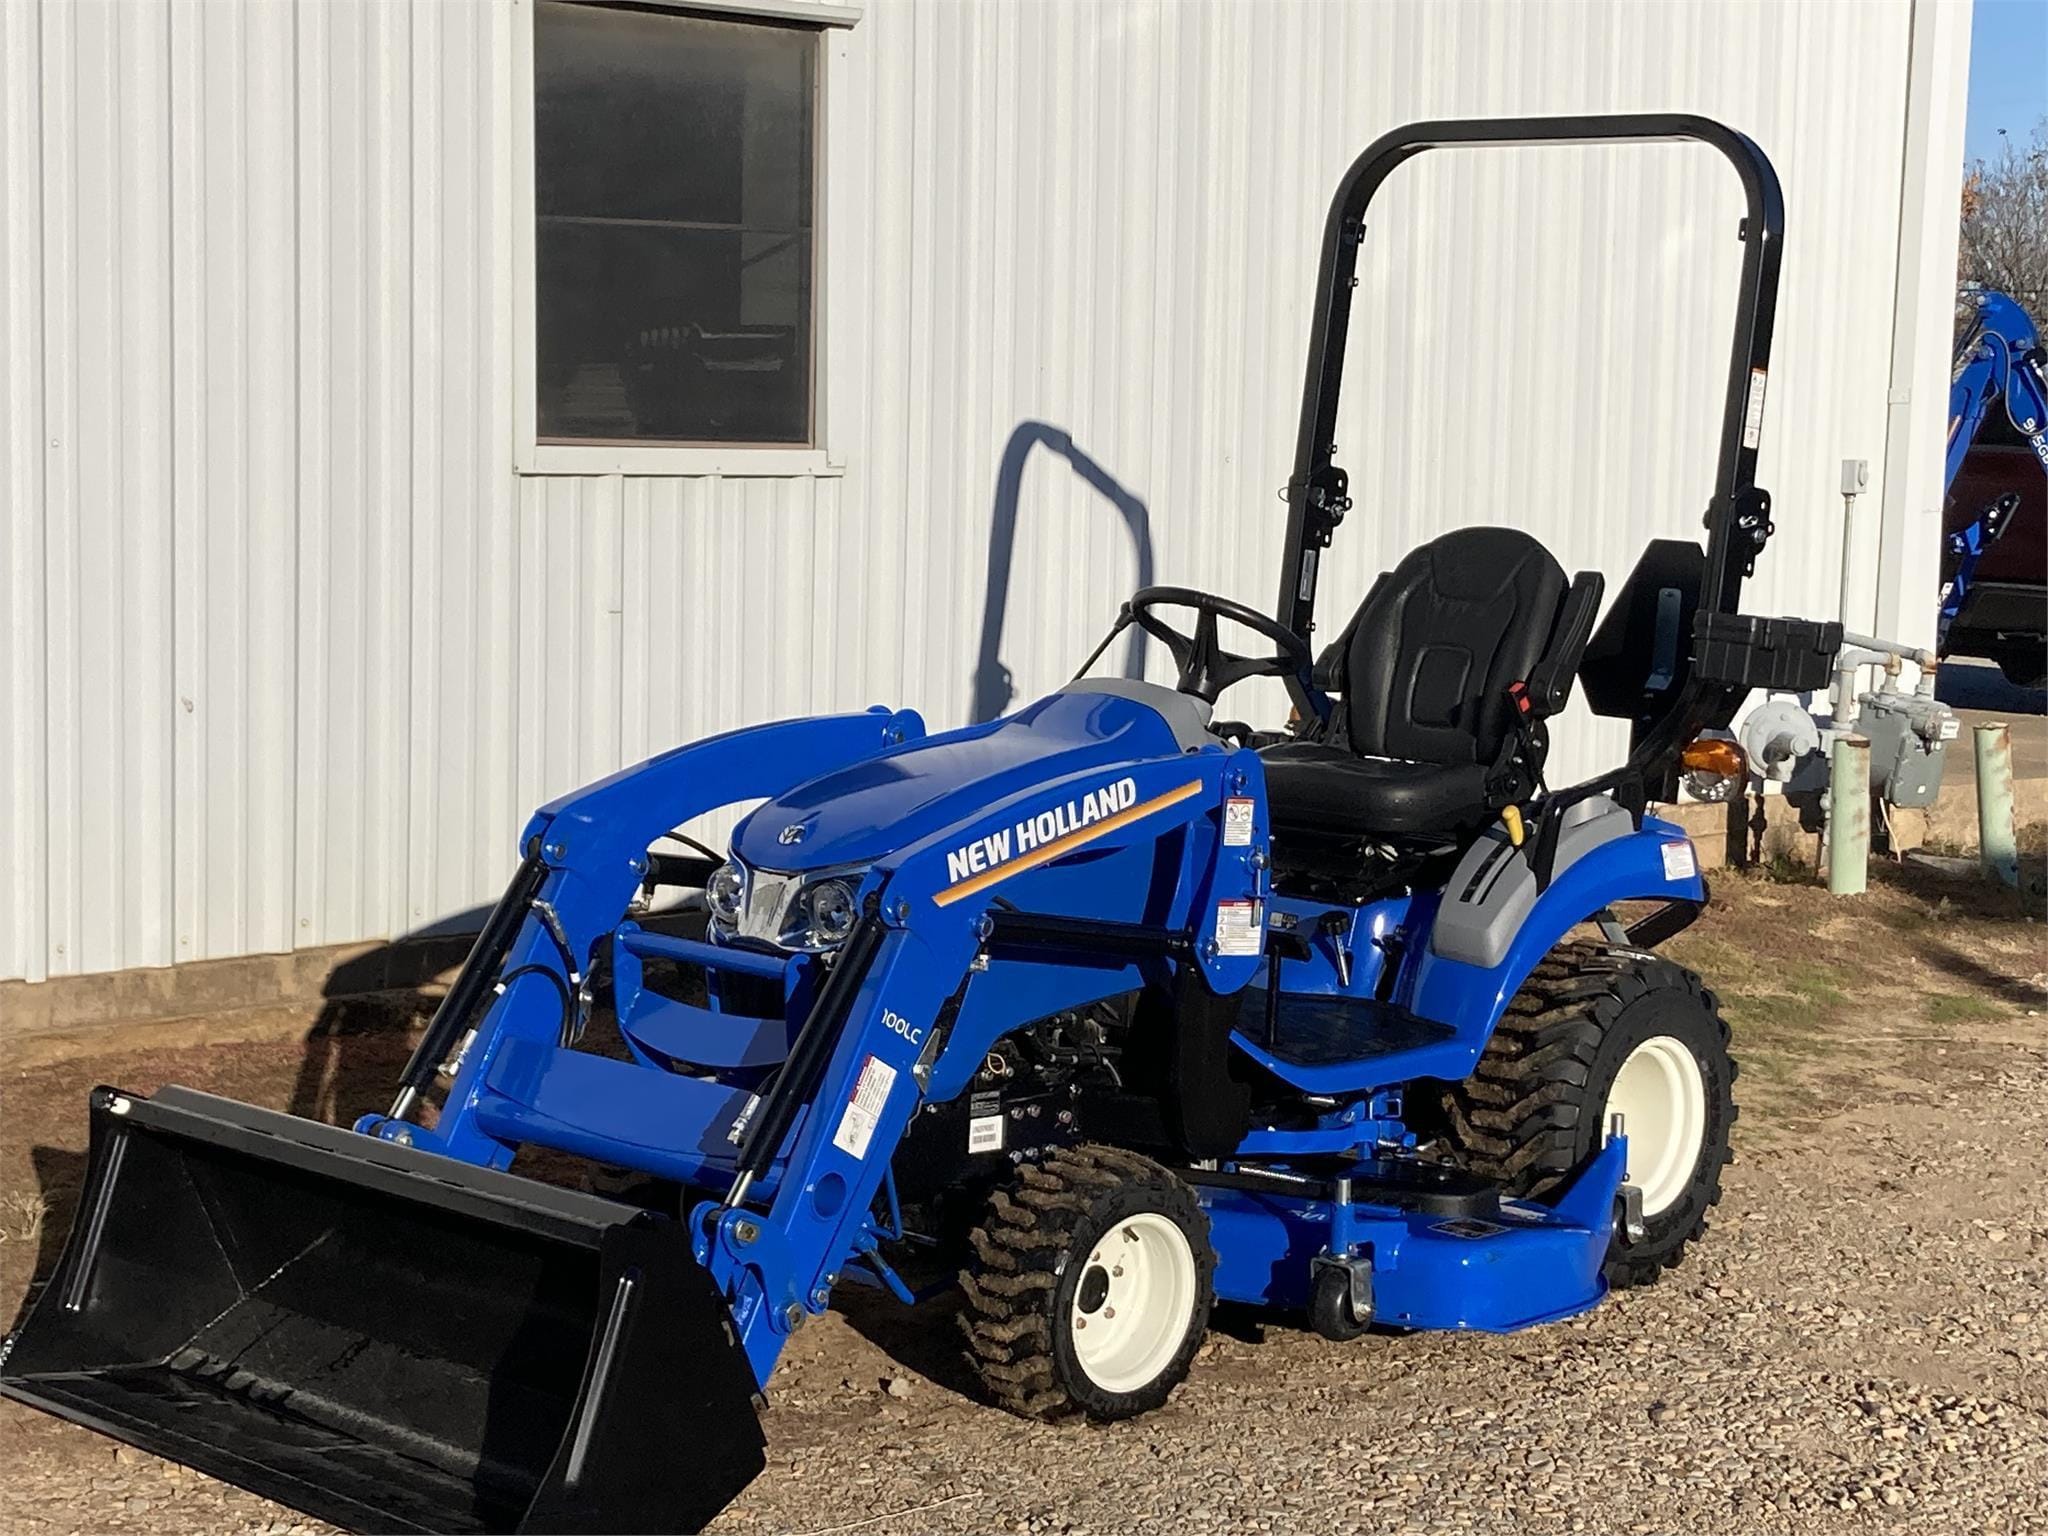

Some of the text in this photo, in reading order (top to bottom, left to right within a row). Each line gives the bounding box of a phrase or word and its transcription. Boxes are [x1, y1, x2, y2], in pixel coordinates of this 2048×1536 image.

[947, 777, 1136, 883] NEW HOLLAND
[881, 1007, 922, 1045] 100LC
